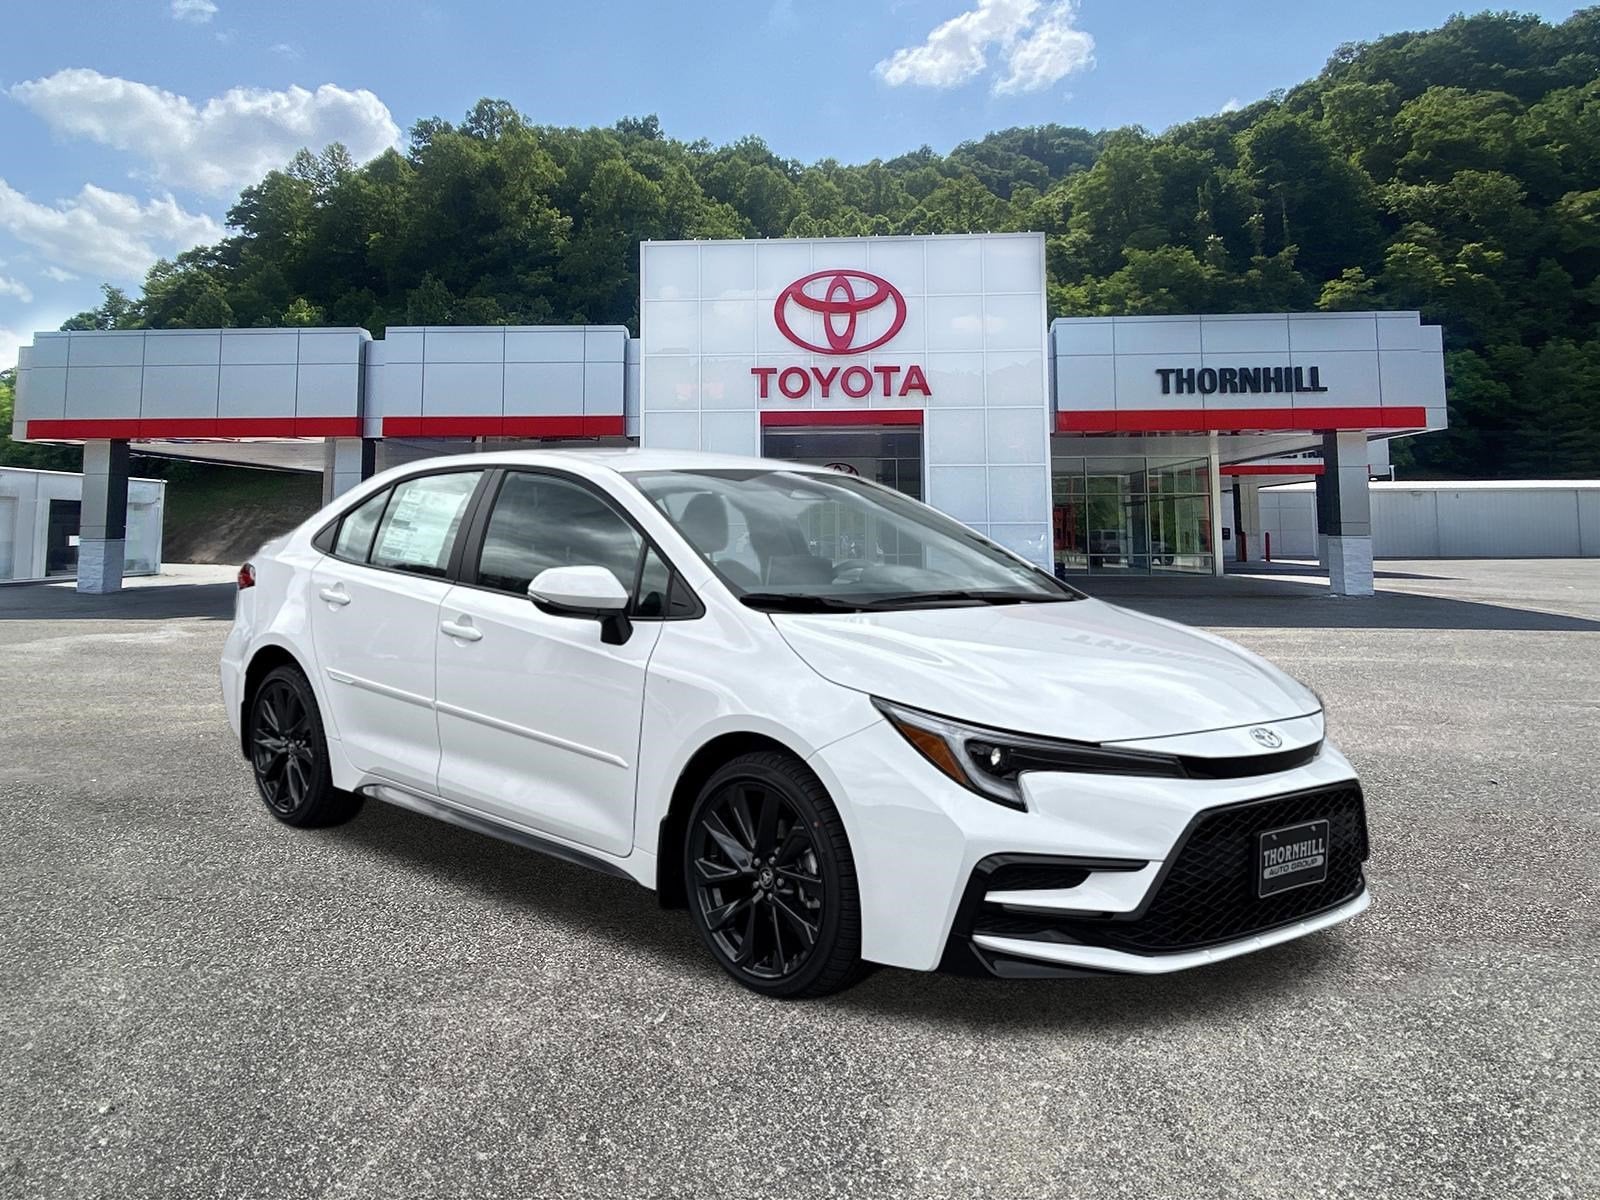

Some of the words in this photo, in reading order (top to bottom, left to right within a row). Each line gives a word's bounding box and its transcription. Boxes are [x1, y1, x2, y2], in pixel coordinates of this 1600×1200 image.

[751, 365, 932, 399] TOYOTA
[1155, 366, 1328, 394] THORNHILL
[1264, 838, 1325, 866] THORNHILL
[1269, 864, 1289, 875] AUTO
[1291, 857, 1317, 870] GROUP
